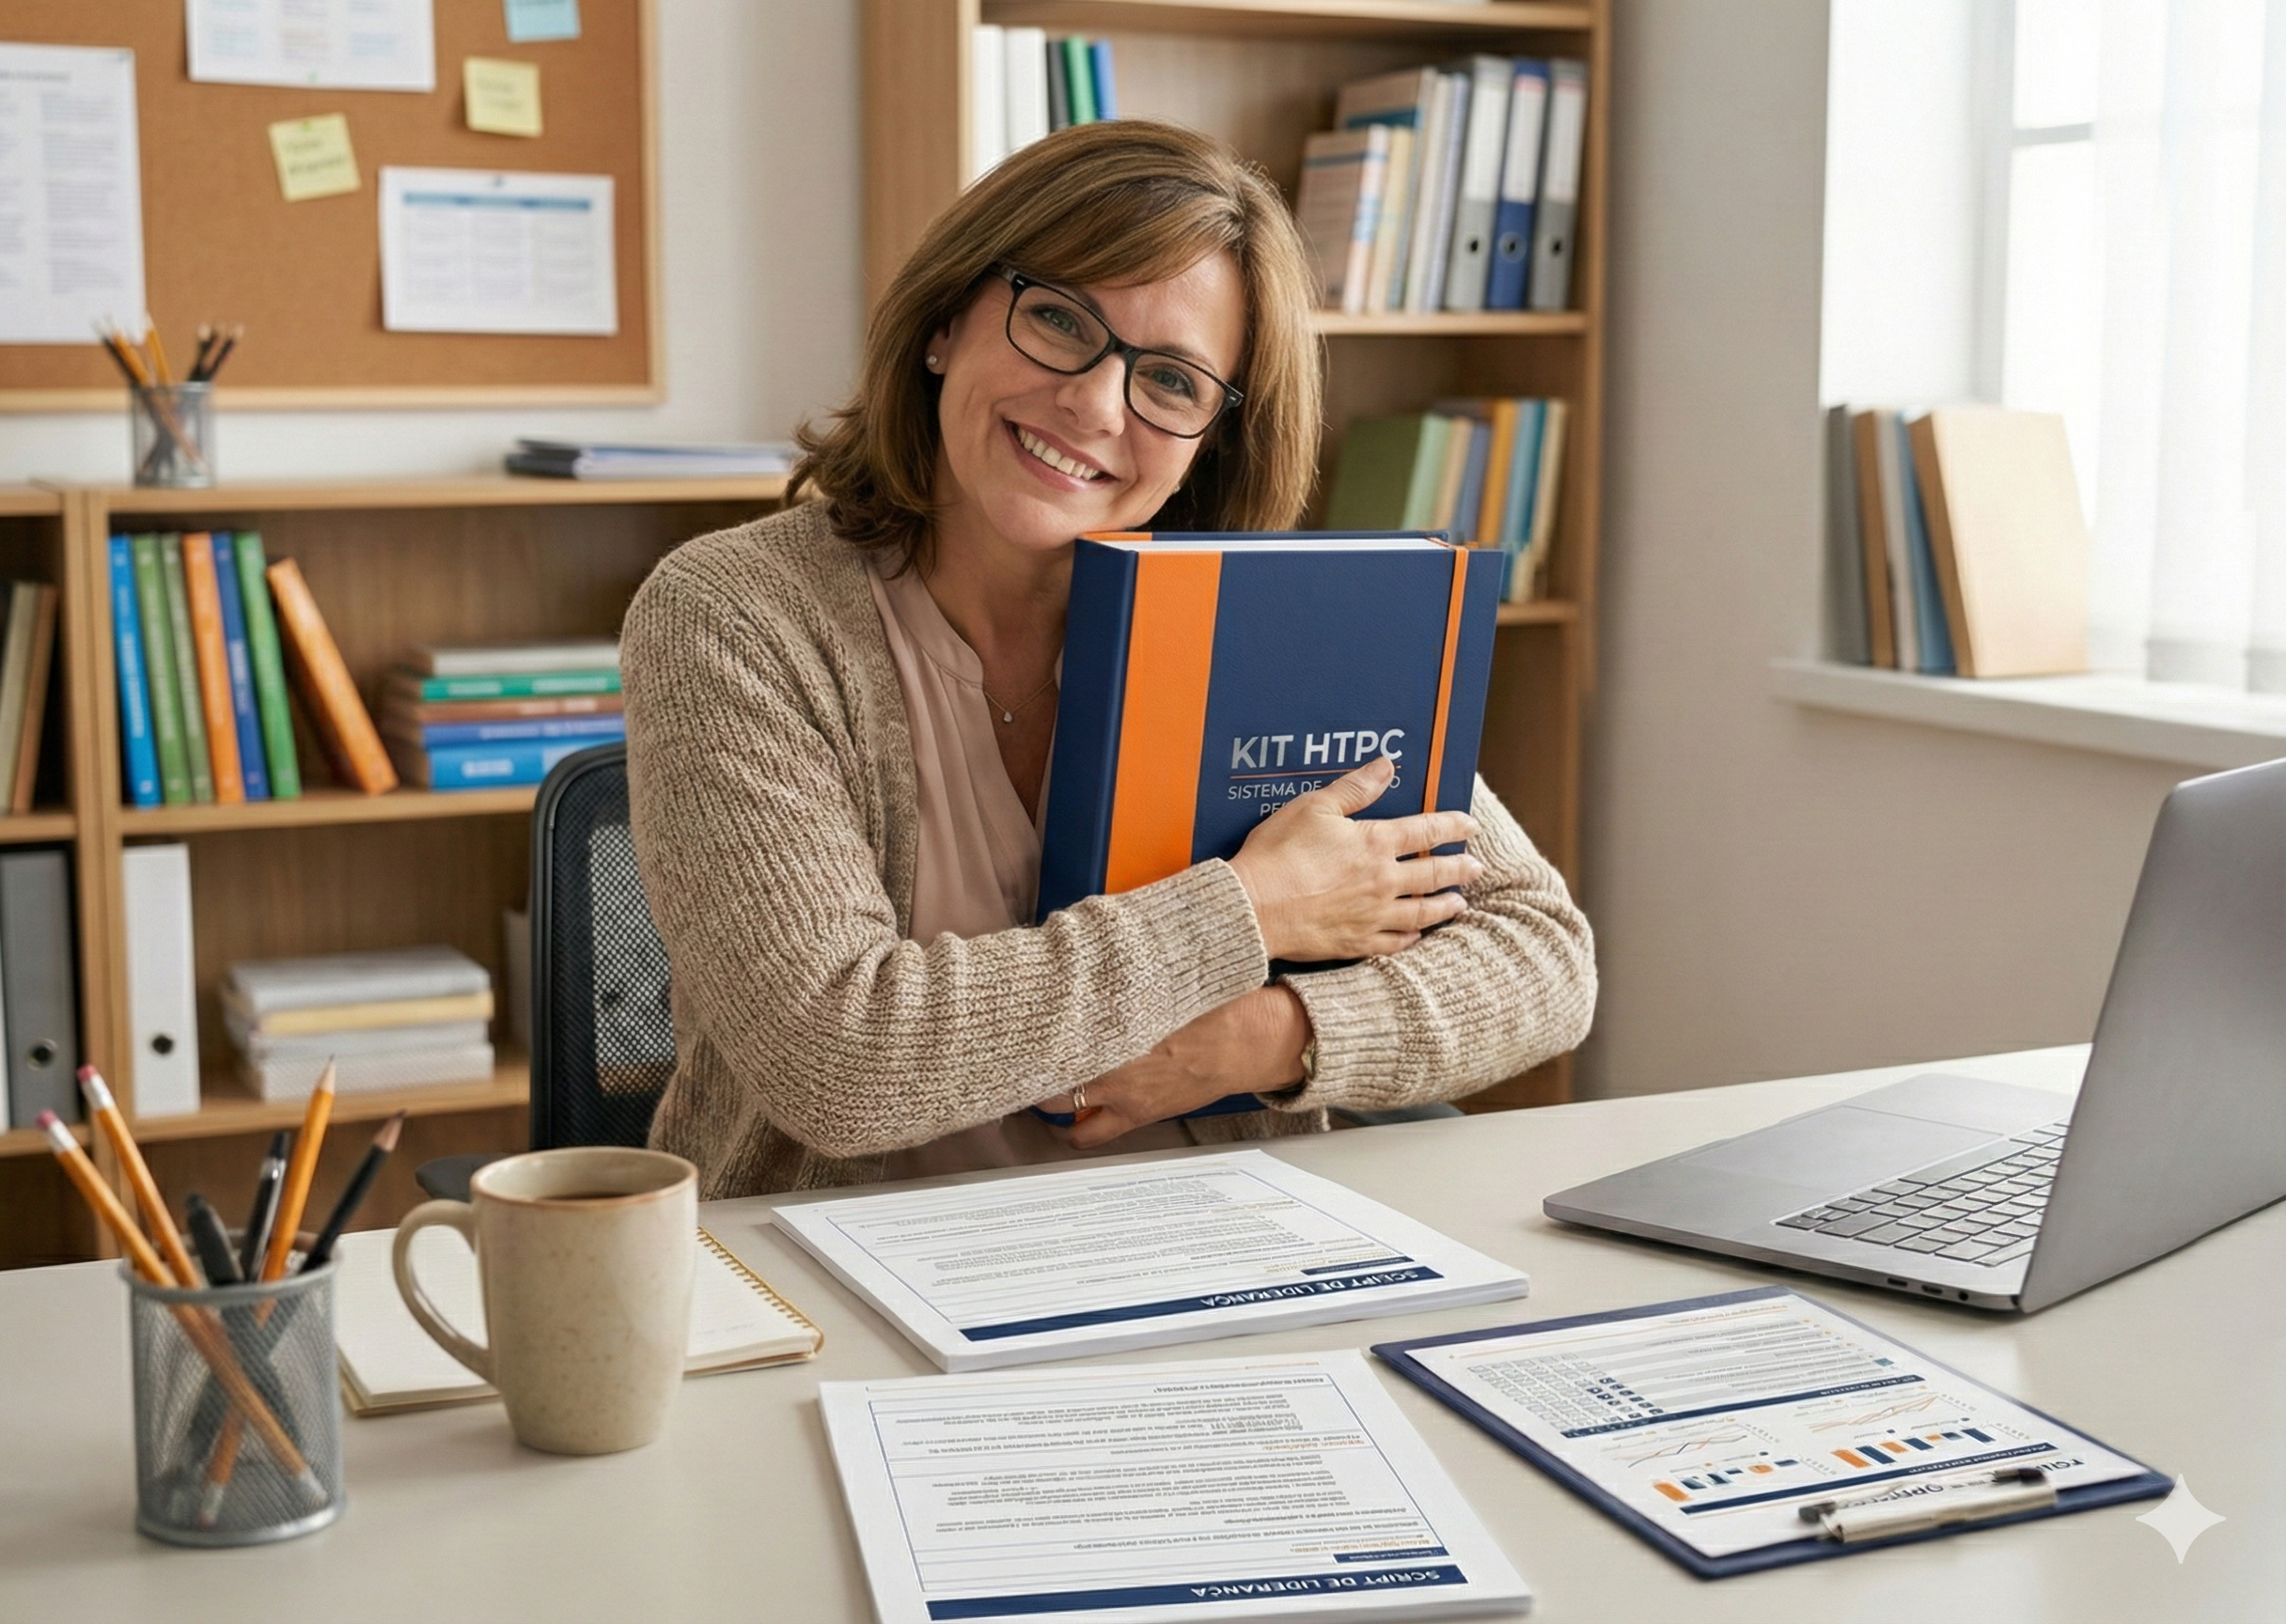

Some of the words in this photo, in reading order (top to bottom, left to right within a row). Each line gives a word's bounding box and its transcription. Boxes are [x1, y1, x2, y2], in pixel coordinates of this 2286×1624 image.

[1231, 735, 1293, 769] KIT
[1304, 728, 1405, 765] HTPC
[1228, 781, 1296, 800] SISTEMA
[1325, 1577, 1356, 1588] DE
[1364, 1570, 1441, 1585] SCRIPT
